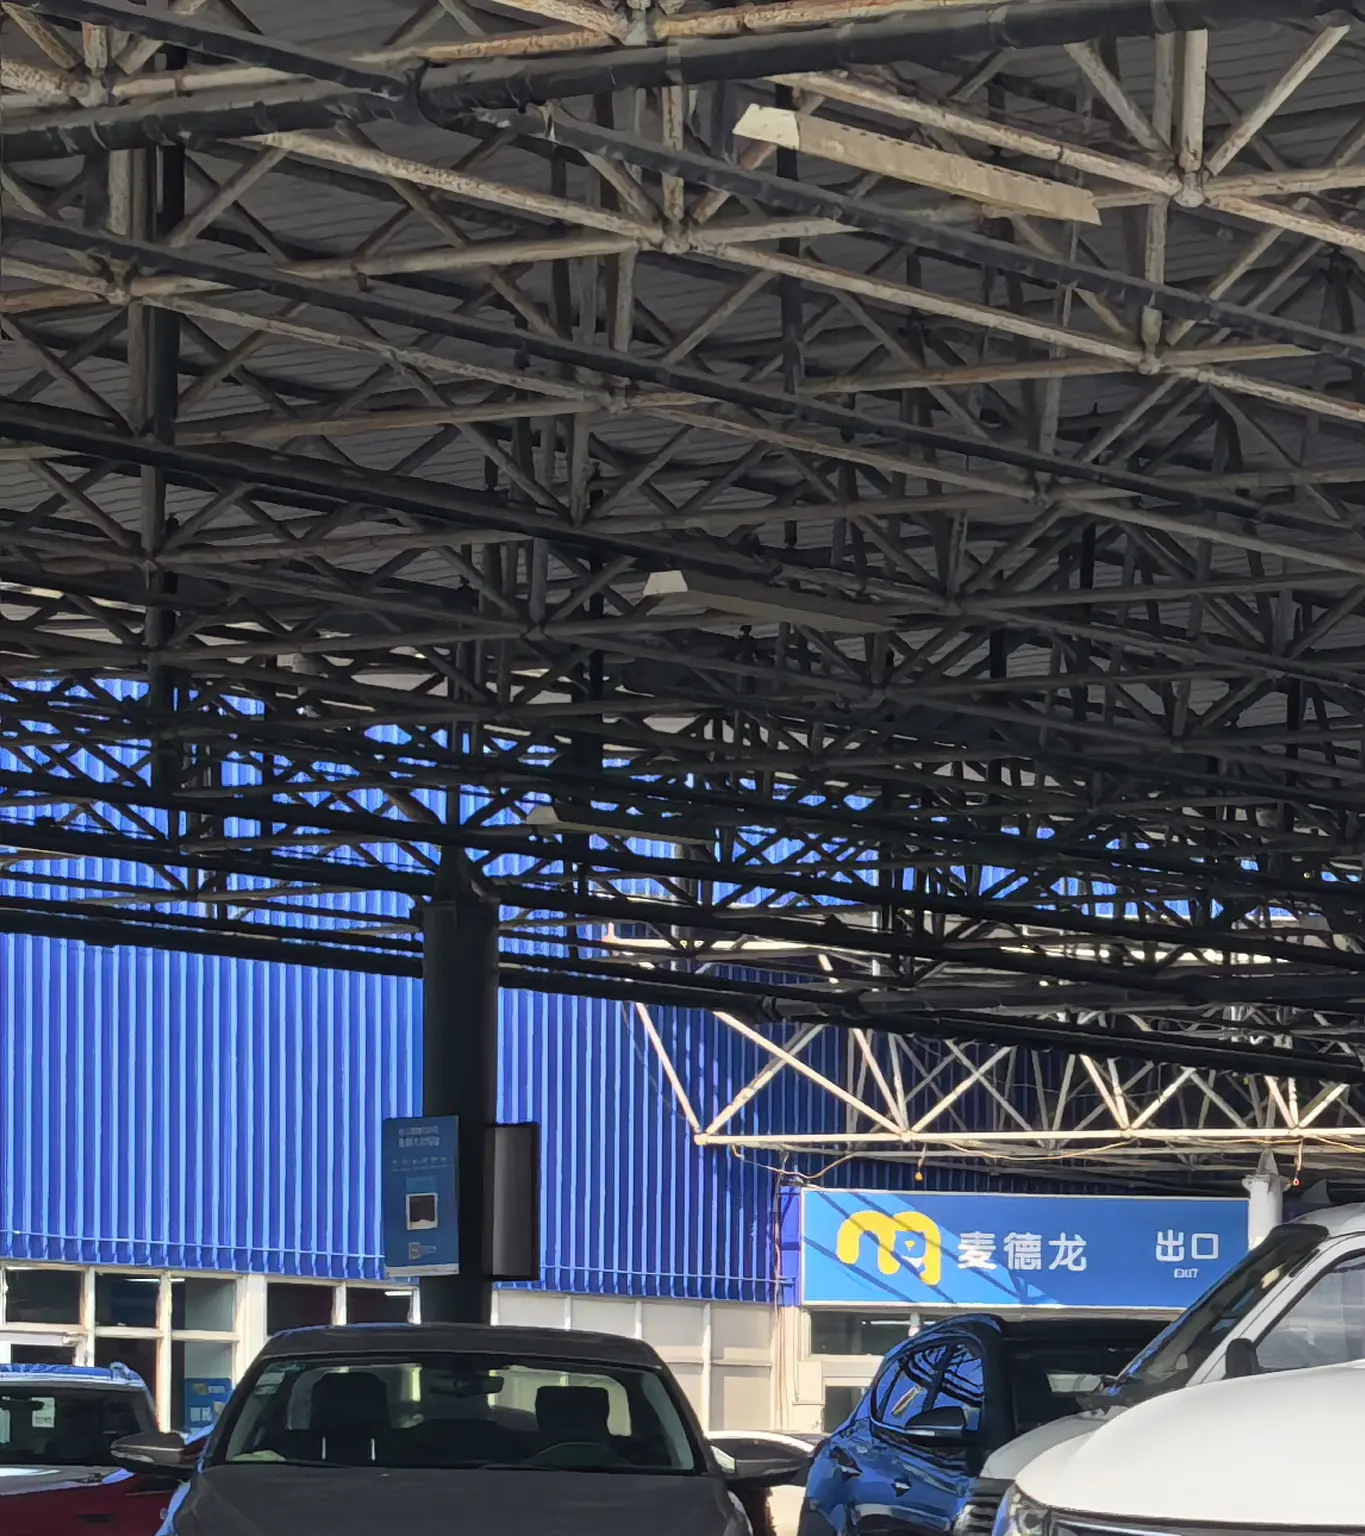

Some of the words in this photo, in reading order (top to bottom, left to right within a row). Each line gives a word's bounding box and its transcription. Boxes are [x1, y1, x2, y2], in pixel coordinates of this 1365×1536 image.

[957, 1231, 1088, 1272] 麦德龙
[1155, 1229, 1220, 1263] 出口
